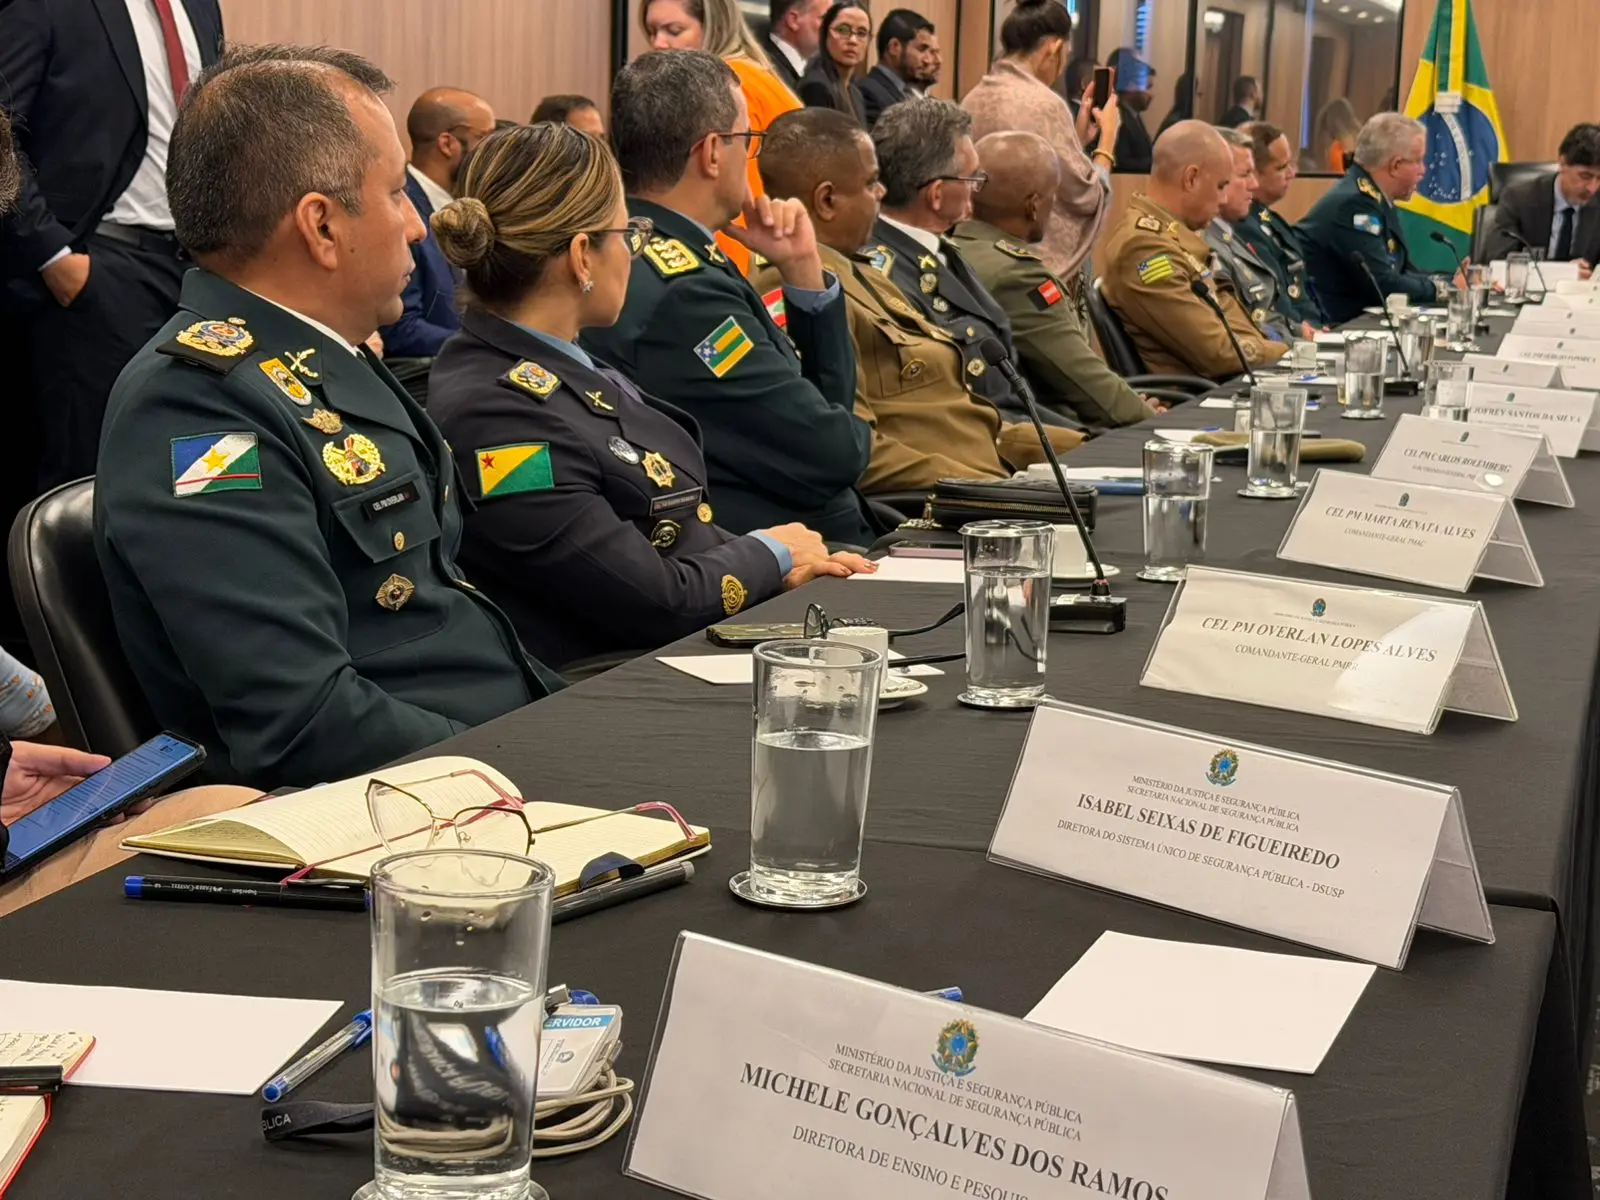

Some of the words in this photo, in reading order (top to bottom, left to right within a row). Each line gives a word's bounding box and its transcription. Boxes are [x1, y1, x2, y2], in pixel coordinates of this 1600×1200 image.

[1431, 452, 1461, 464] CARLOS
[1461, 457, 1512, 473] ROLEMBERG
[1325, 506, 1344, 517] CEL
[1345, 509, 1362, 520] PM
[1363, 512, 1397, 527] MARTA
[1398, 517, 1439, 533] RENATA
[1440, 525, 1477, 540] ALVES
[1201, 616, 1229, 631] CEL
[1231, 620, 1256, 634] PM
[1256, 623, 1331, 645] OVERLAN
[1330, 634, 1383, 653] LOPES
[1383, 644, 1438, 662] ALVES
[1235, 643, 1331, 668] COMANDANTE-GERAL
[1077, 793, 1135, 820] ISABEL
[1136, 807, 1198, 835] SEIXAS
[1199, 822, 1225, 842] DE
[1226, 828, 1340, 869] FIGUEIREDO
[1127, 785, 1170, 802] SECRETARIA
[1170, 795, 1208, 812] NACIONAL
[1208, 803, 1220, 814] DE
[1220, 806, 1266, 825] SEGURANÇA
[1265, 816, 1299, 833] PÚBLICA
[1173, 784, 1184, 794] DA
[1215, 793, 1221, 802] E
[1221, 795, 1267, 813] SEGURANÇA
[1267, 805, 1300, 821] PÚBLICA
[1057, 819, 1101, 839] DIRETORA
[1102, 830, 1116, 842] DO
[1116, 834, 1155, 852] SISTEMA
[1156, 840, 1187, 859] ÚNICO
[1187, 851, 1201, 863] DE
[1201, 855, 1260, 878] SEGURANÇA
[1261, 869, 1304, 889] PÚBLICA
[1311, 882, 1345, 899] DSUSP
[828, 1057, 891, 1087] SECRETARIA
[891, 1076, 946, 1102] NACIONAL
[948, 1093, 962, 1107] DE
[964, 1098, 1032, 1128] SEGURANÇA
[1033, 1116, 1082, 1142] PÚBLICA
[834, 1043, 895, 1070] MINISTÉRIO
[896, 1060, 911, 1075] DA
[912, 1066, 955, 1087] JUSTIÇA
[957, 1079, 964, 1090] E
[965, 1080, 1033, 1111] SEGURANÇA
[1034, 1100, 1082, 1125] PÚBLICA
[740, 1062, 851, 1114] MICHELE
[855, 1097, 1007, 1161] GONÇALVES
[1010, 1142, 1065, 1179] DOS
[1070, 1160, 1169, 1200] RAMOS
[792, 1125, 866, 1162] DIRETORA
[868, 1148, 890, 1169] DE
[891, 1155, 948, 1186] ENSINO
[950, 1174, 962, 1191] E
